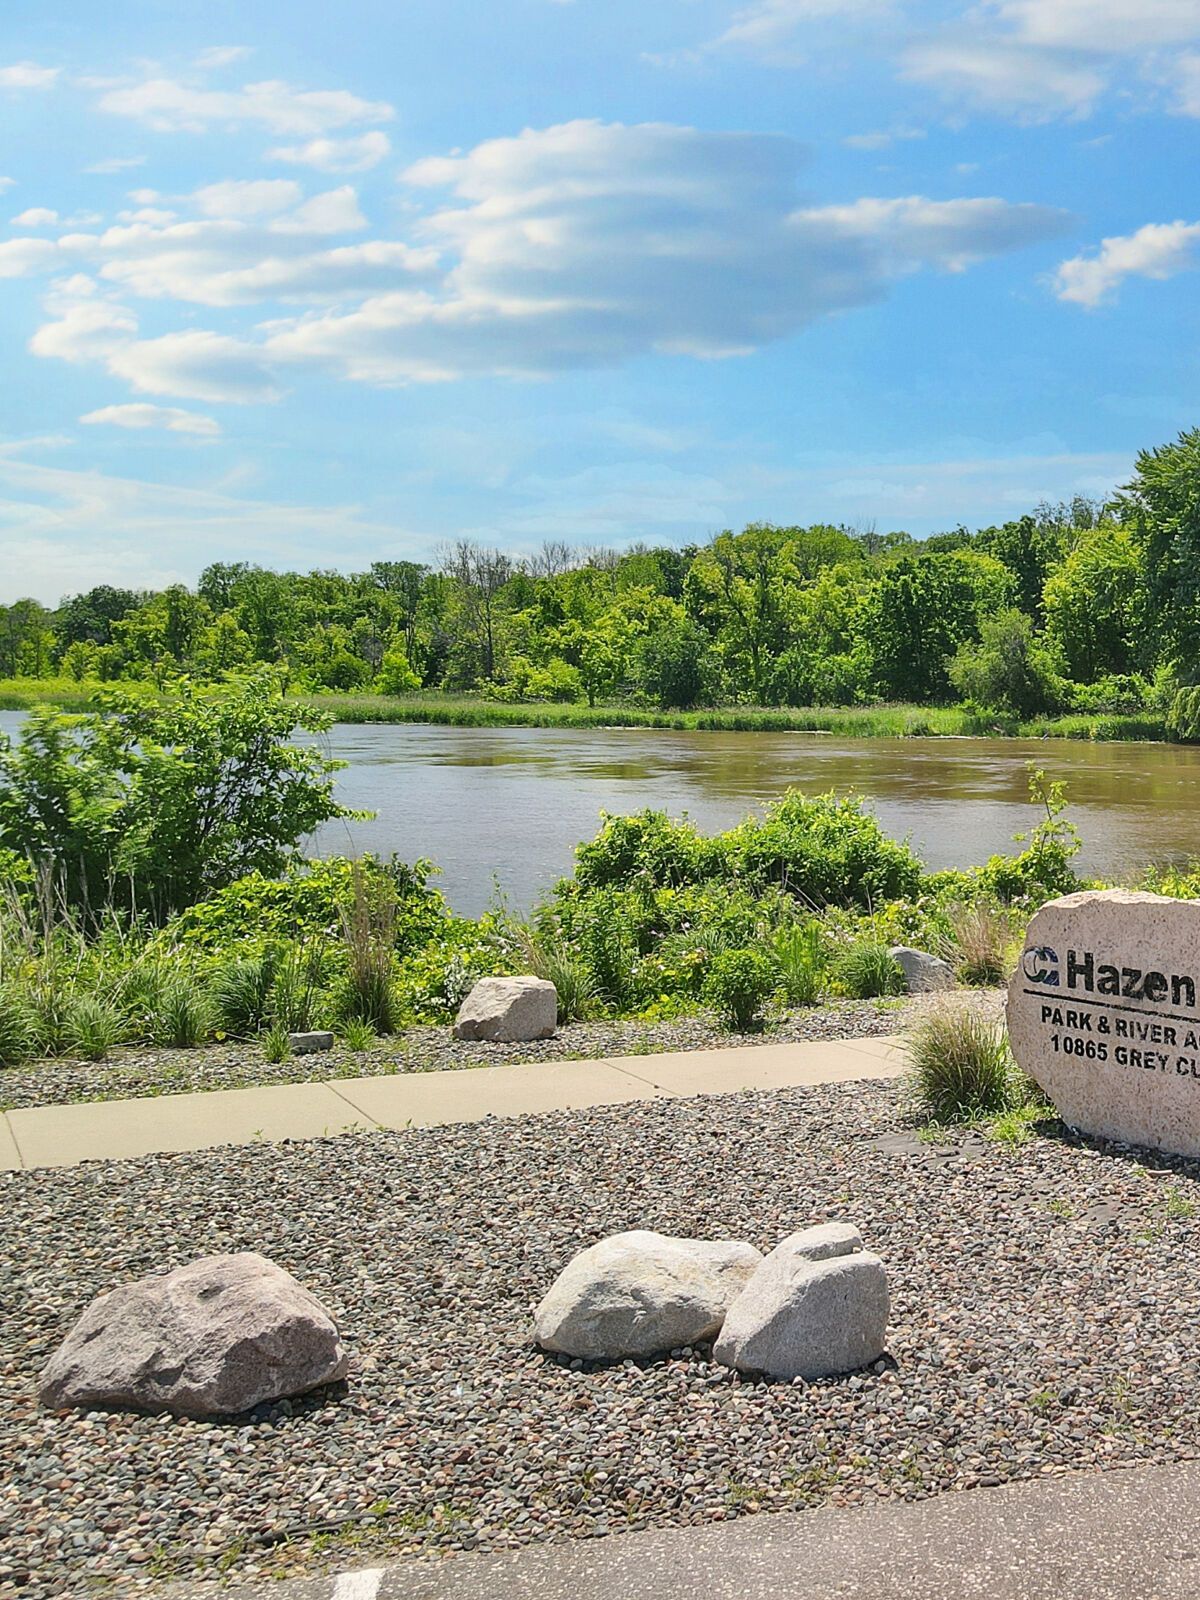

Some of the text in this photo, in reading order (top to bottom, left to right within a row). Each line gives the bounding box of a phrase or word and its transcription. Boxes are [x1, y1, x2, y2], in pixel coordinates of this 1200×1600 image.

[1066, 950, 1196, 1007] Hazen
[1041, 1005, 1092, 1031] PARK
[1097, 1015, 1110, 1034] &
[1115, 1018, 1177, 1046] RIVER
[1051, 1034, 1108, 1061] 10865
[1114, 1046, 1170, 1072] GREY
